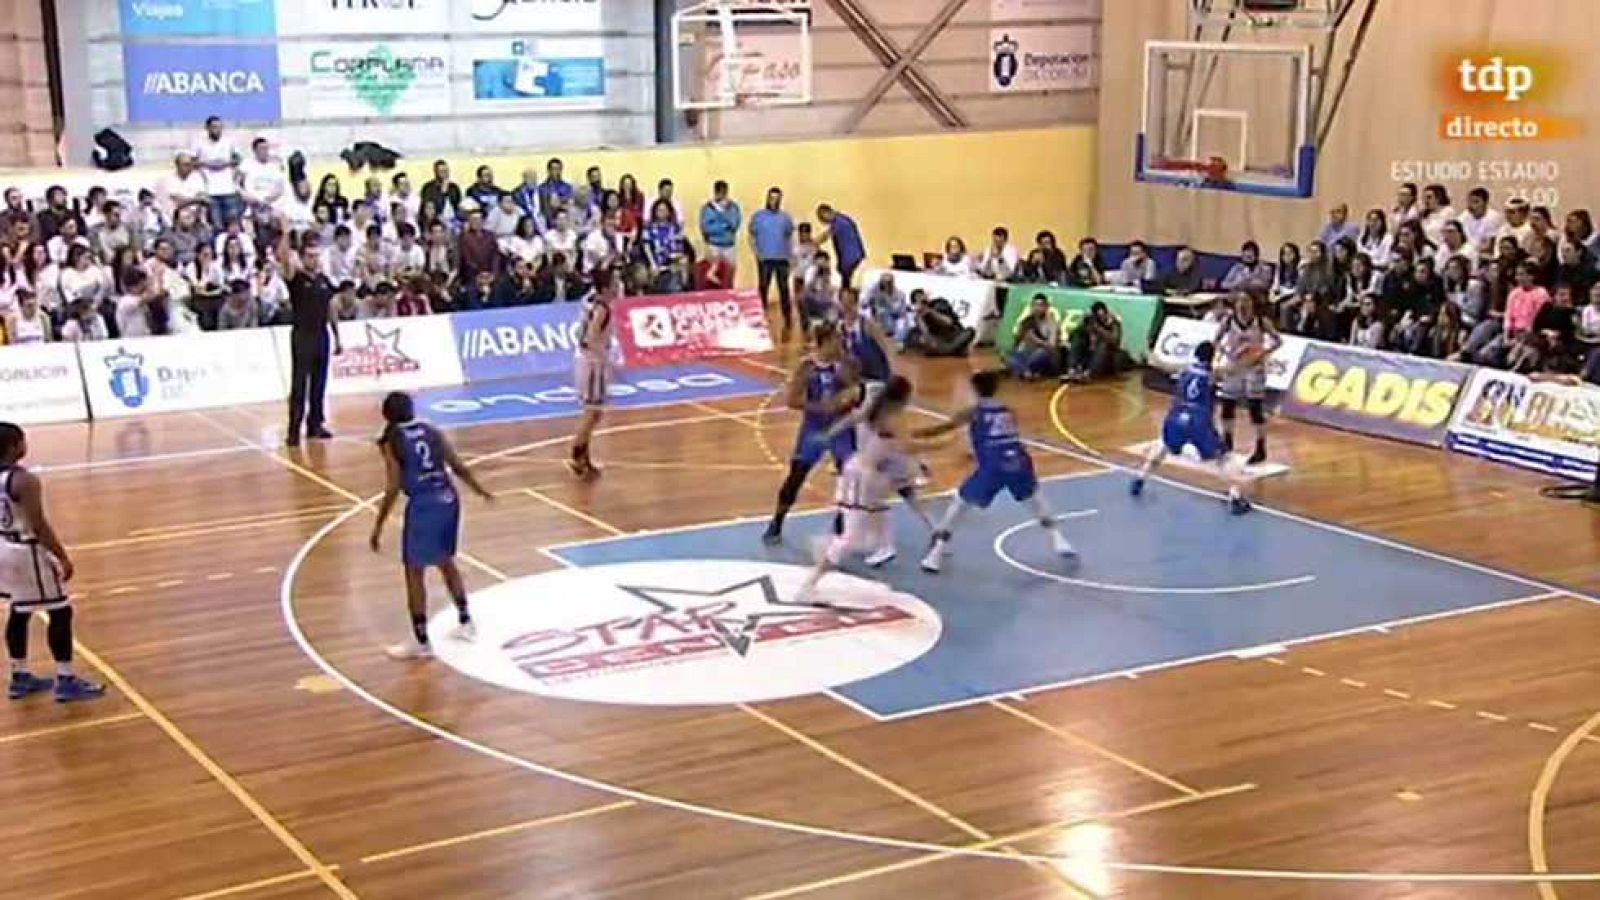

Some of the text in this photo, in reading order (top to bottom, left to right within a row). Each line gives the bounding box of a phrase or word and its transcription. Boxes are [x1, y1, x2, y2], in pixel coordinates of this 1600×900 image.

[1295, 360, 1459, 428] GADIS
[415, 440, 434, 469] 2
[502, 601, 737, 660] STAR
